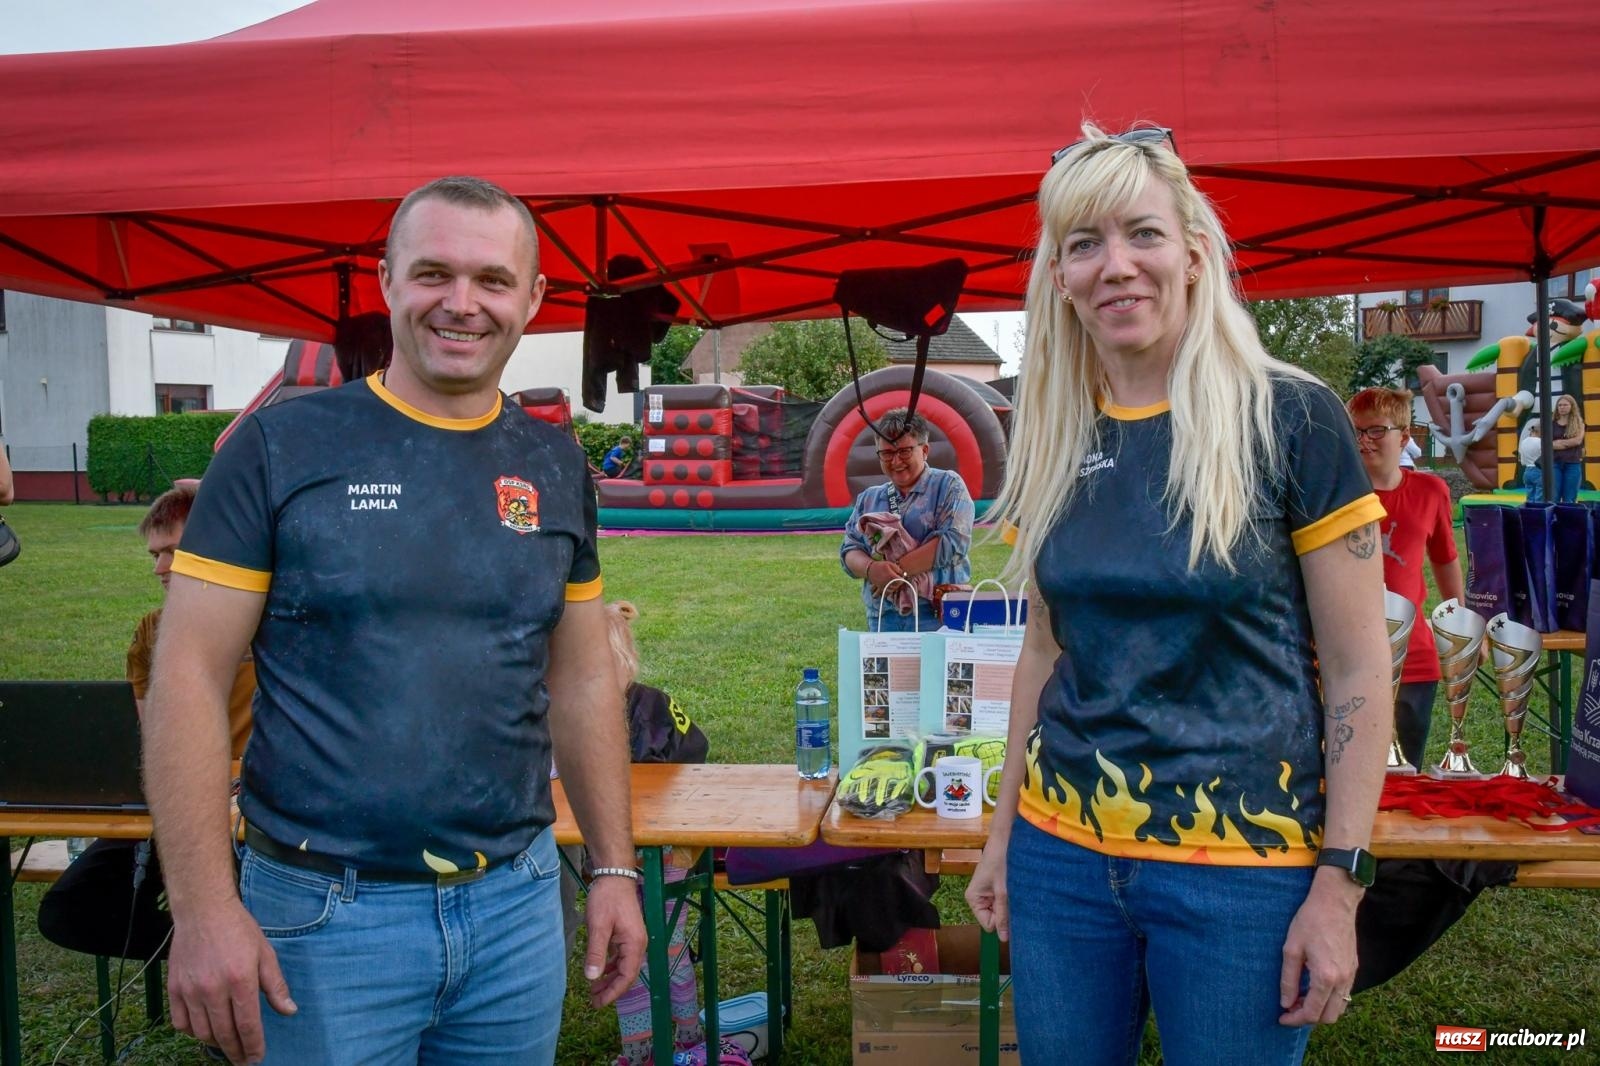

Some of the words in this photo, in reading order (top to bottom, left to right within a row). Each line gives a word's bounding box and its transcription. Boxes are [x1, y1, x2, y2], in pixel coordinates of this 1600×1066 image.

[347, 483, 402, 496] MARTIN
[350, 498, 398, 511] LAMLA
[896, 974, 929, 983] Lyreco
